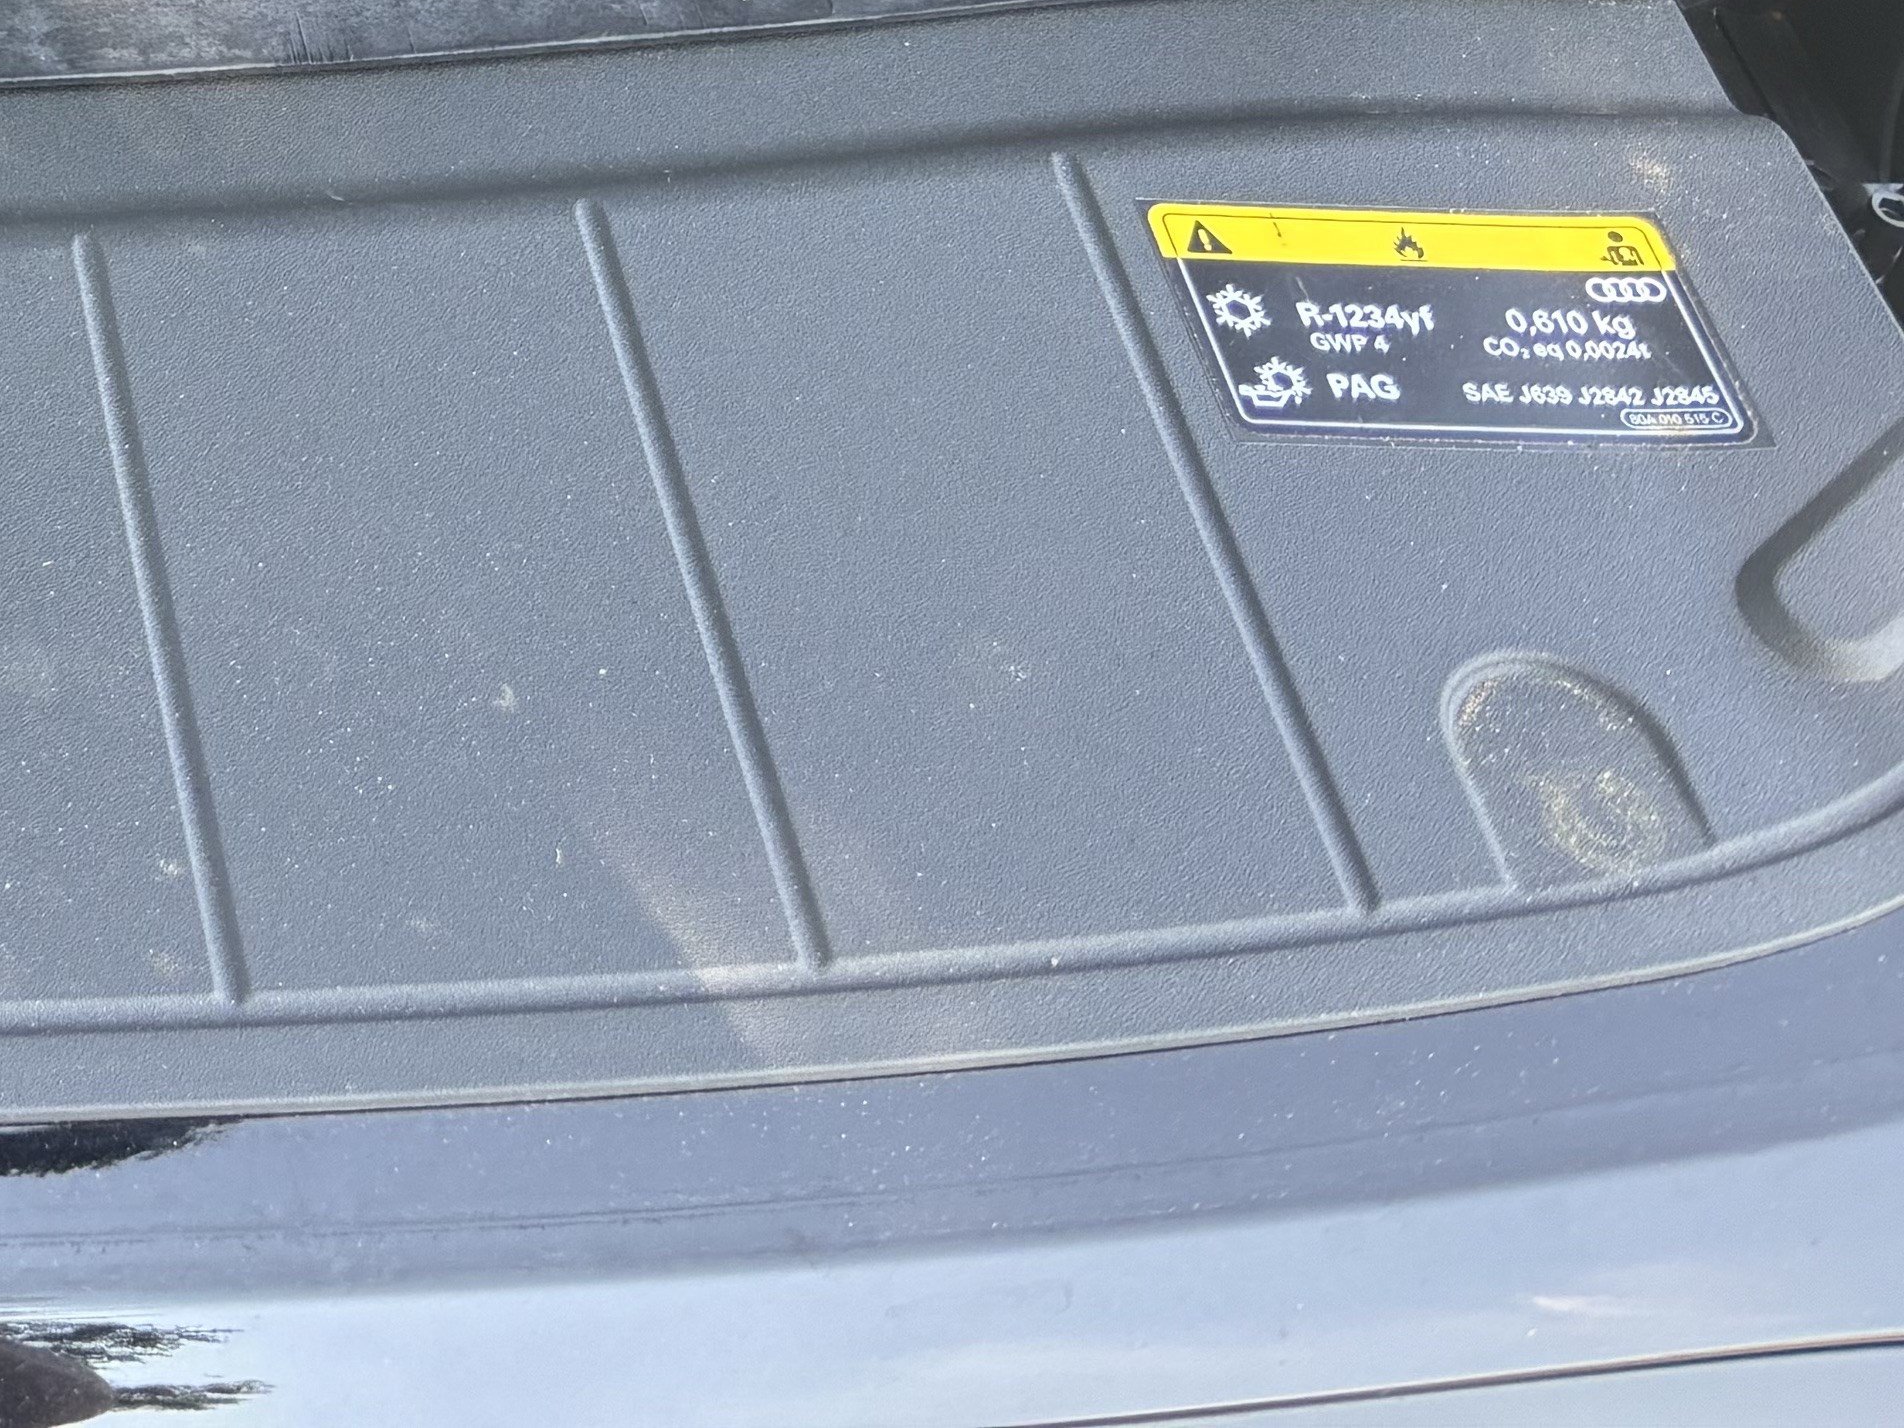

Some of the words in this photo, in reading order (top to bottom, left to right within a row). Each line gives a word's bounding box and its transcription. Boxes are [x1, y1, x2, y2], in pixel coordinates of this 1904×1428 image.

[1295, 298, 1434, 334] R-1234yf
[1504, 307, 1589, 337] 0,610
[1590, 309, 1636, 340] kg
[1309, 332, 1369, 353] GWP
[1373, 334, 1391, 354] 4
[1325, 372, 1401, 401] PAG
[1461, 381, 1514, 403] SAE
[1518, 382, 1573, 405] J639
[1577, 385, 1646, 406] J2842
[1650, 385, 1719, 406] J2845
[1658, 413, 1683, 424] 010
[1710, 412, 1724, 424] C
